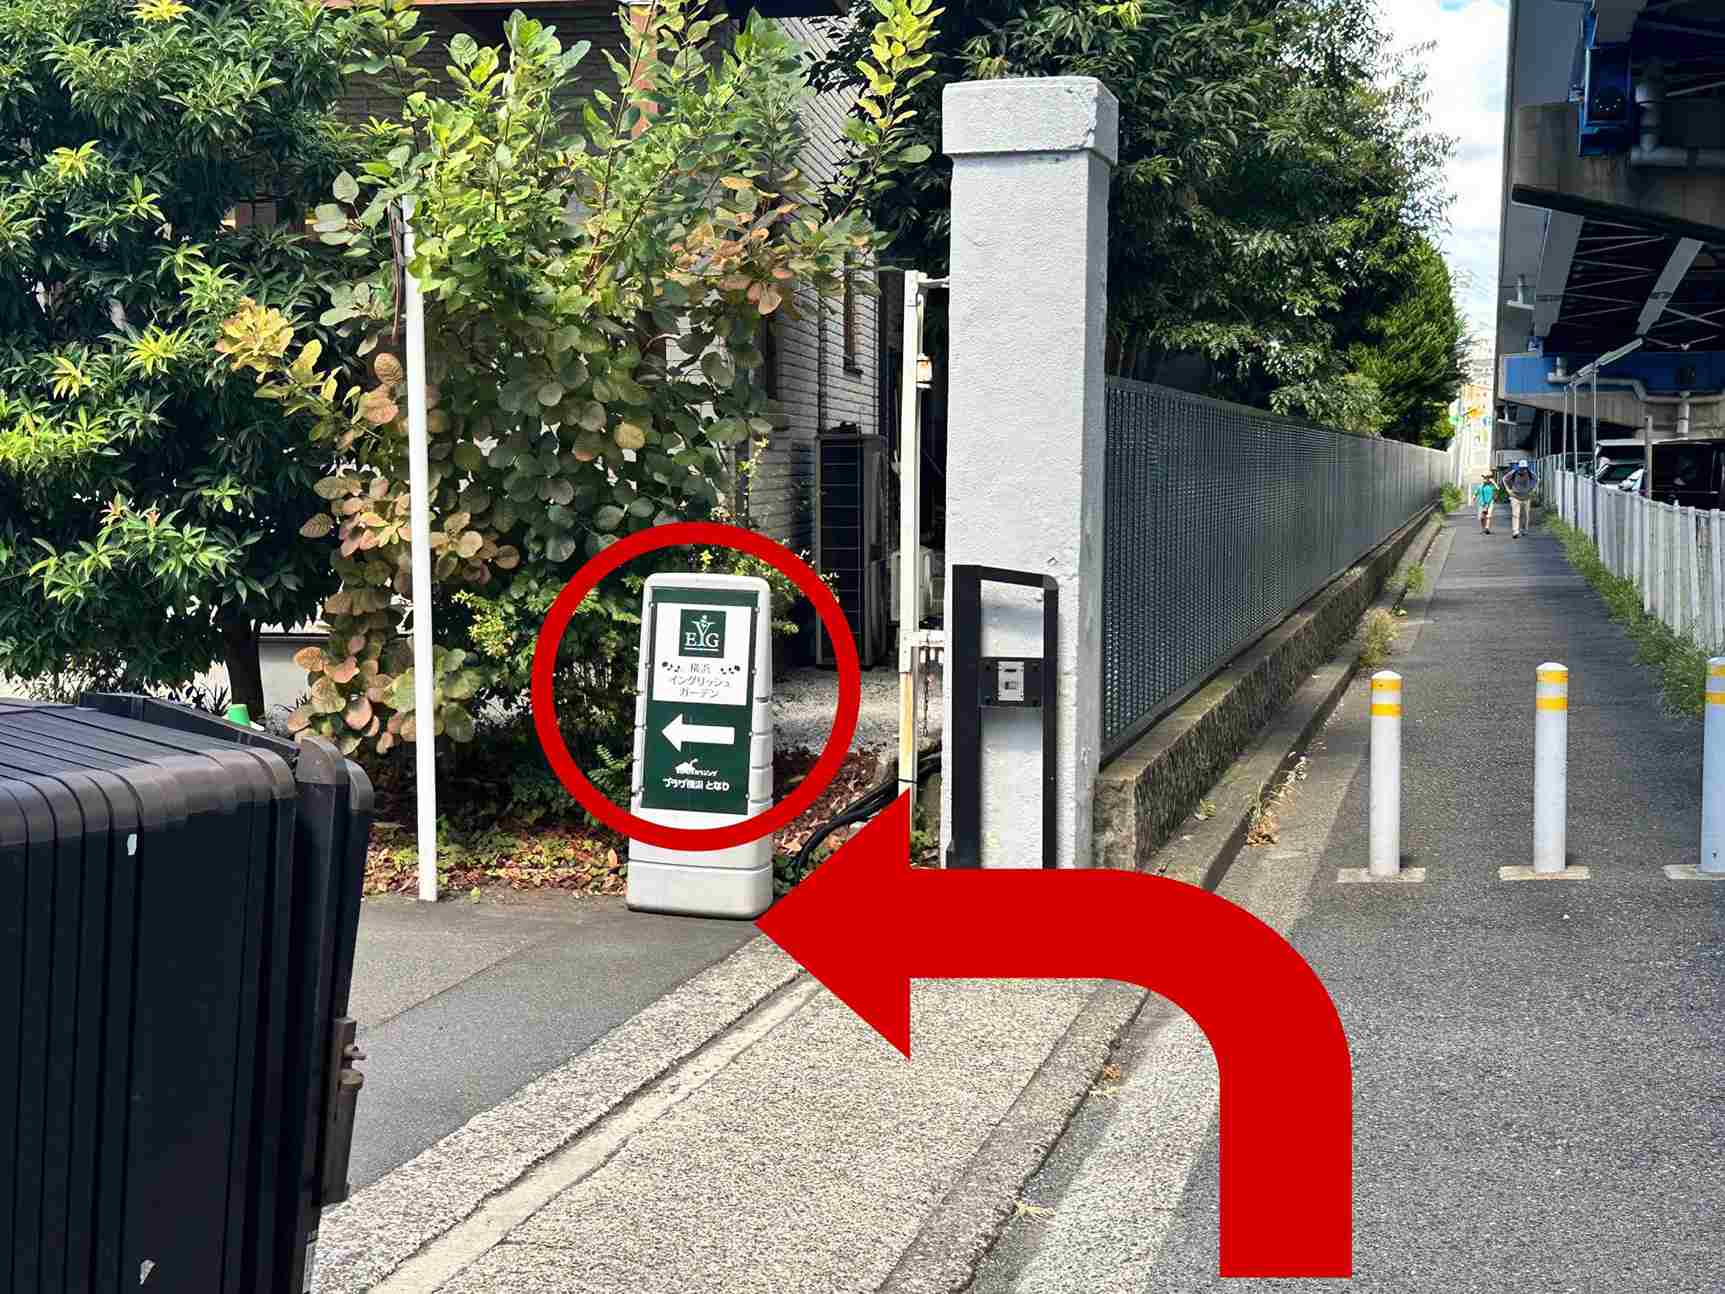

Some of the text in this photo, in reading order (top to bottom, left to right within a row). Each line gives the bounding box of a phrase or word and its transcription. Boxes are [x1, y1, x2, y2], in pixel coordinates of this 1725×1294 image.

[672, 675, 730, 687] イングリッシュ
[679, 687, 719, 698] ガーデン
